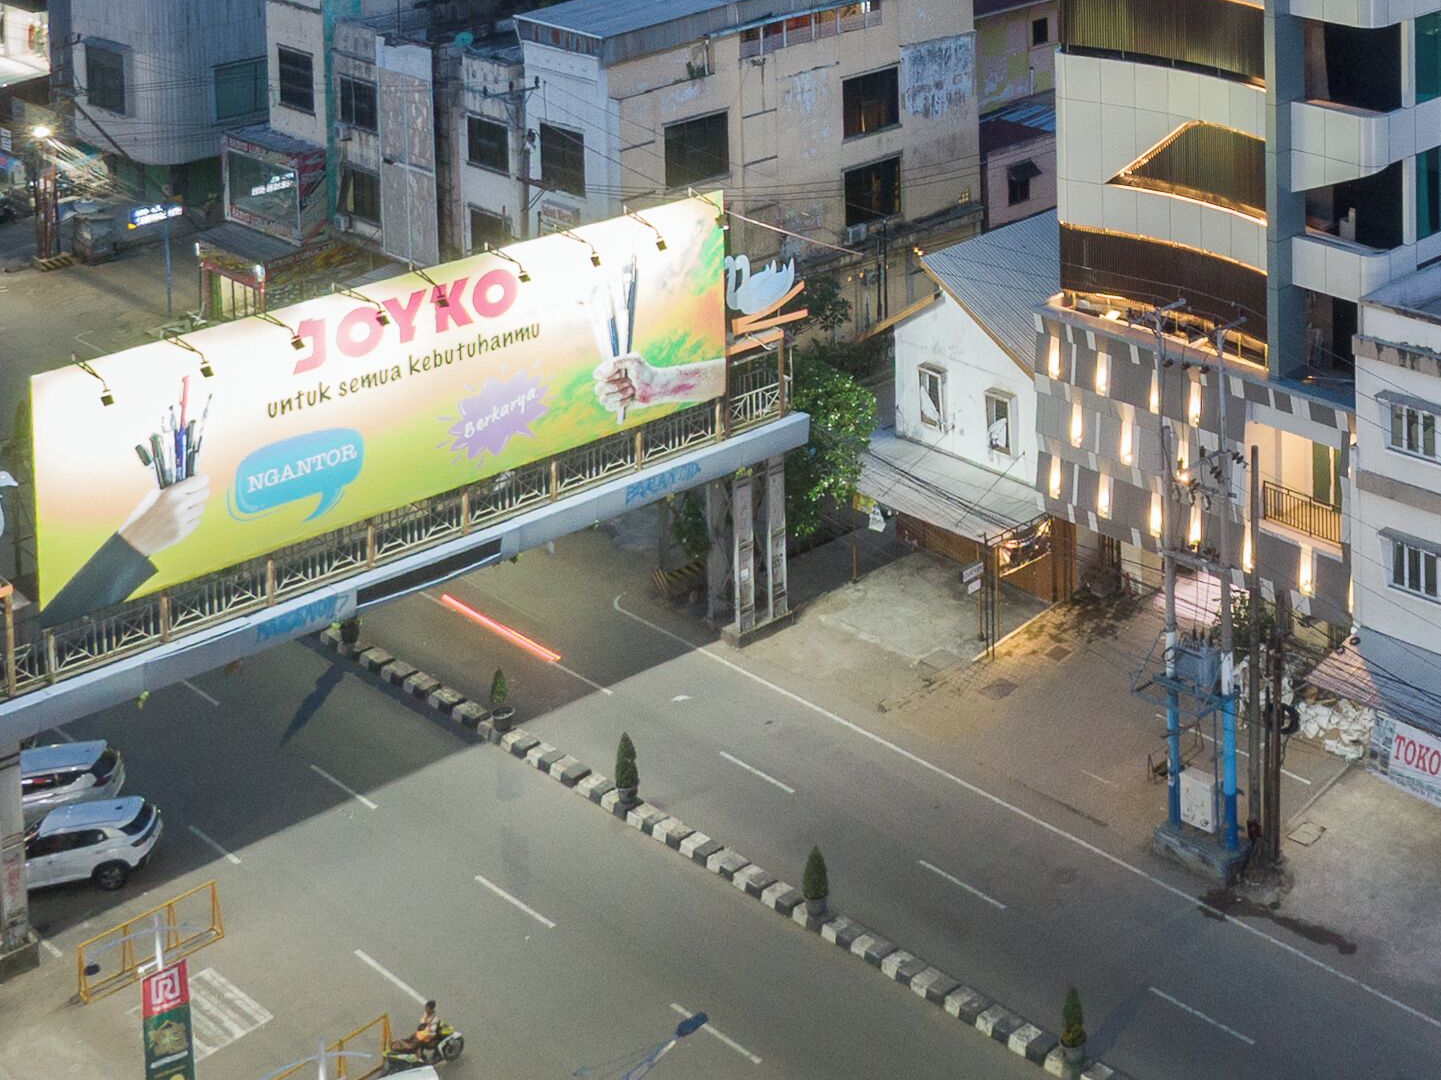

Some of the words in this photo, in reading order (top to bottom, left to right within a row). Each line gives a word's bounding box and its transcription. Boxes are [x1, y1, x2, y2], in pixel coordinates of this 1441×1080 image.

[292, 269, 519, 376] JOYKO
[267, 381, 332, 419] untuk
[338, 364, 402, 397] semua
[408, 322, 541, 376] kebutuhanmu
[463, 386, 537, 440] Berkarya
[246, 443, 358, 494] NGANTOR
[1394, 734, 1441, 776] TOKO
